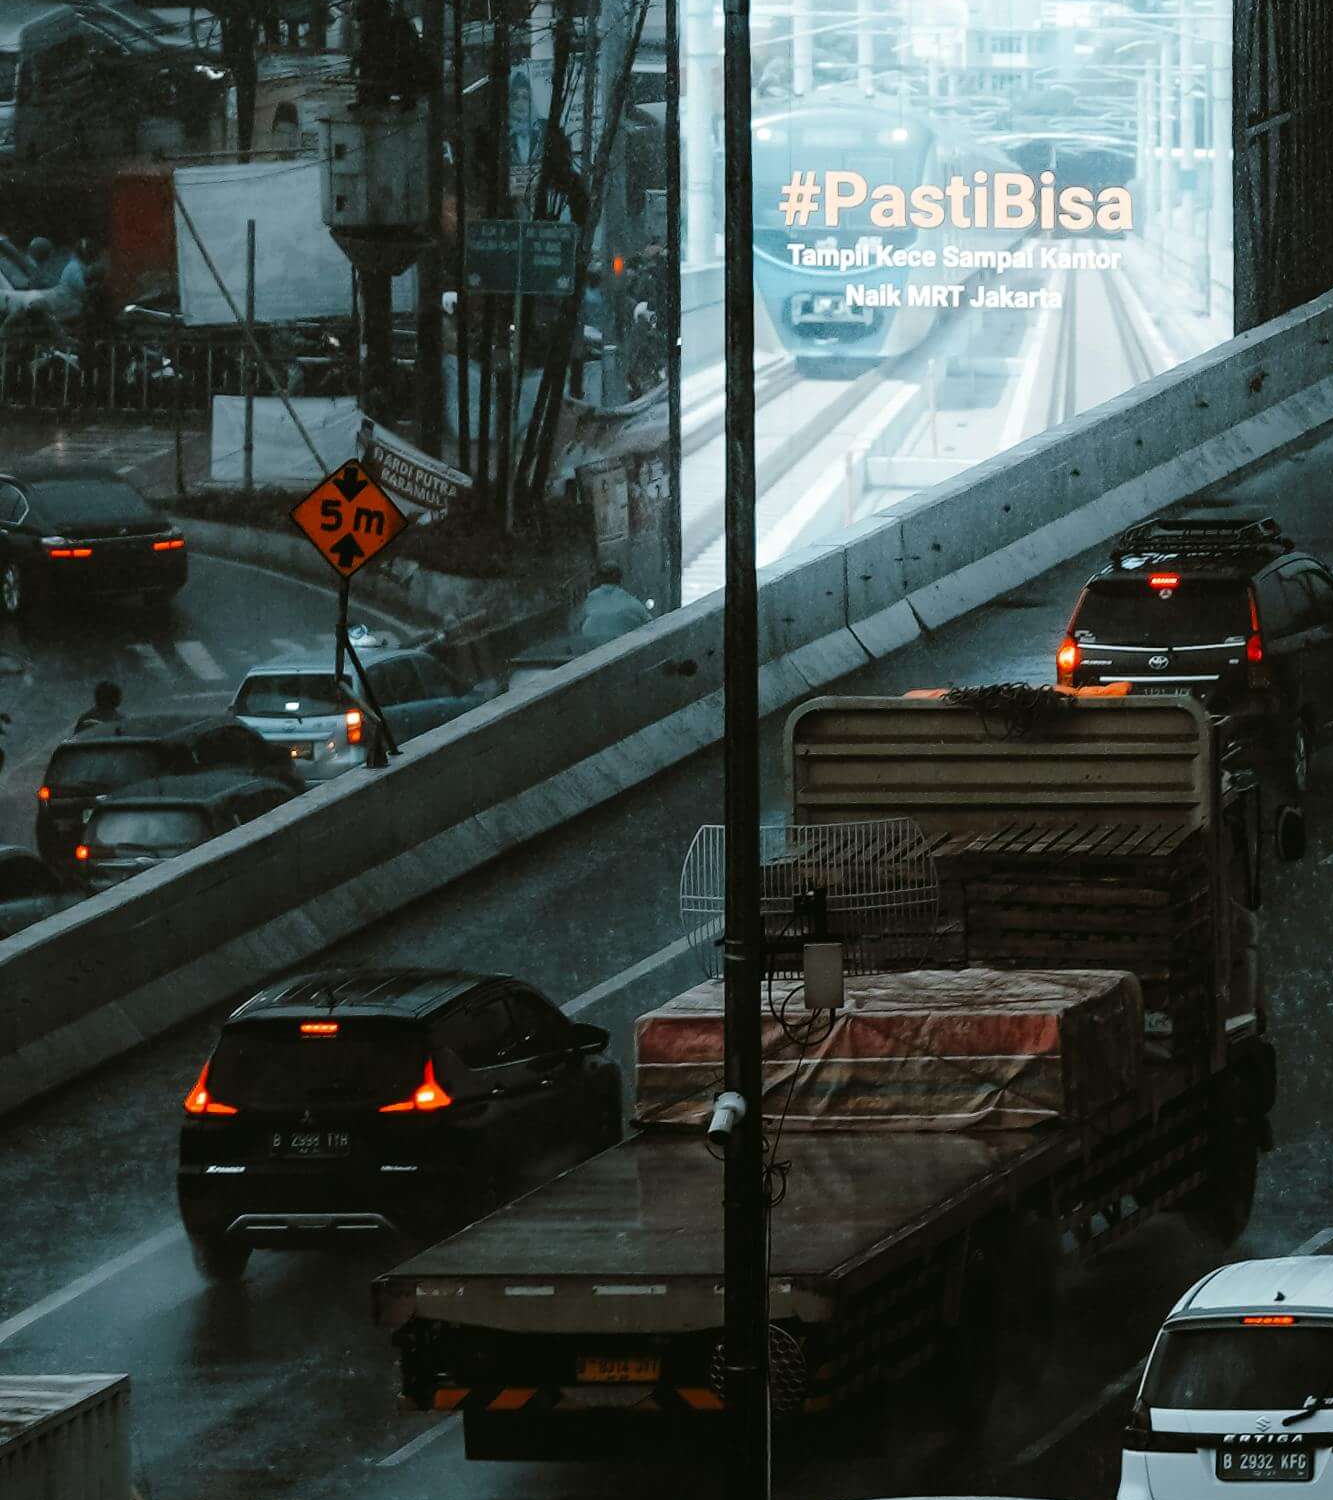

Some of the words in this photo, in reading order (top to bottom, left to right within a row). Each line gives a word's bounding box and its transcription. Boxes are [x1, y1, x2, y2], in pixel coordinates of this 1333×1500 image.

[779, 170, 1134, 231] #PastiBisa
[787, 243, 869, 271] Tampil
[876, 244, 936, 268] Kece
[943, 245, 1034, 273] Sampai
[1041, 247, 1122, 270] Kantor
[845, 284, 901, 307] Naik
[908, 285, 965, 308] MRT
[969, 285, 1063, 309] Jakarta
[320, 499, 342, 531] 5
[353, 506, 384, 535] m
[1223, 1434, 1304, 1443] ERTIGA
[1223, 1453, 1233, 1470] B
[1240, 1453, 1274, 1470] 2932
